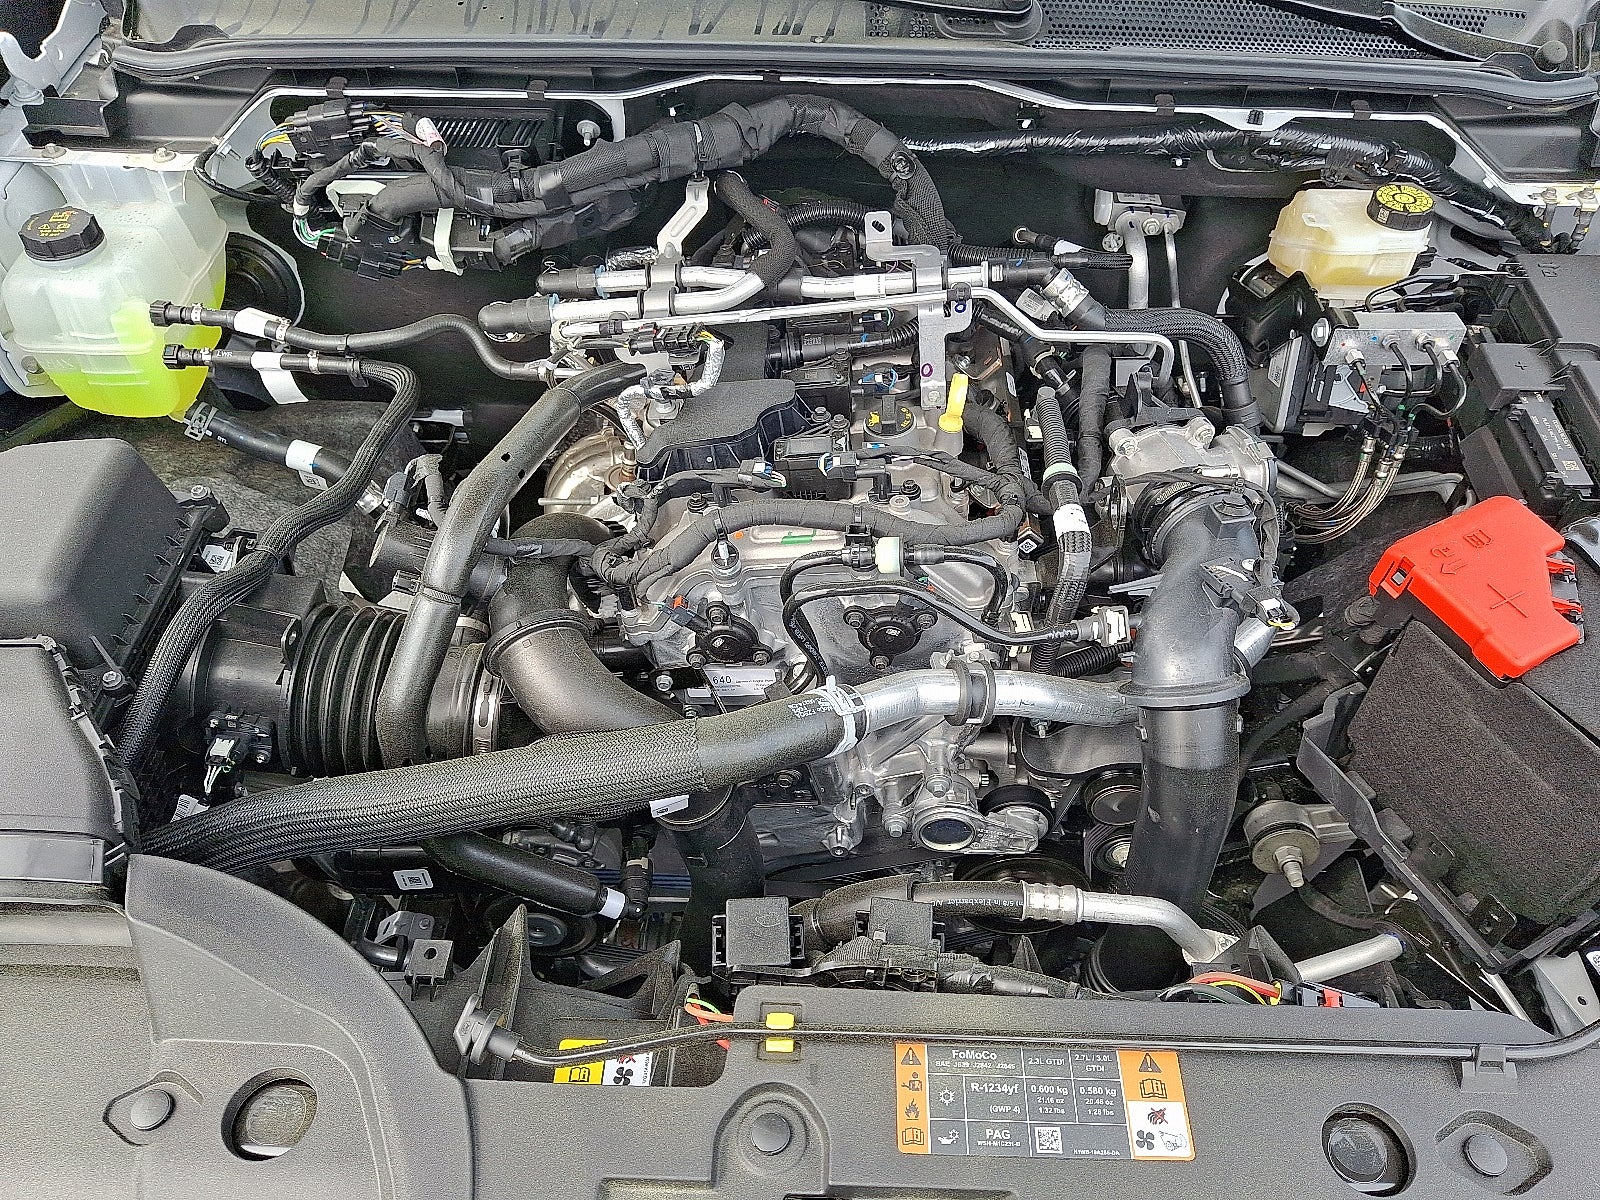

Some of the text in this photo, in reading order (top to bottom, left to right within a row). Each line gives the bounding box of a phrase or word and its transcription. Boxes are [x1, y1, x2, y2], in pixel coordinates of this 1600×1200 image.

[712, 675, 732, 685] 640
[951, 1049, 998, 1060] FoMoCo
[1096, 1054, 1113, 1062] 3.0L
[1028, 1057, 1065, 1066] 2.3L GTDI
[1085, 1064, 1105, 1072] GTDI
[970, 1082, 1020, 1096] R-1234yf
[1030, 1084, 1069, 1096] 0.600 kg
[1079, 1086, 1117, 1097] 0.580 kg
[989, 1104, 1021, 1115] (GWP 4)
[1102, 1108, 1115, 1116] lbs
[985, 1128, 1011, 1140] PAG
